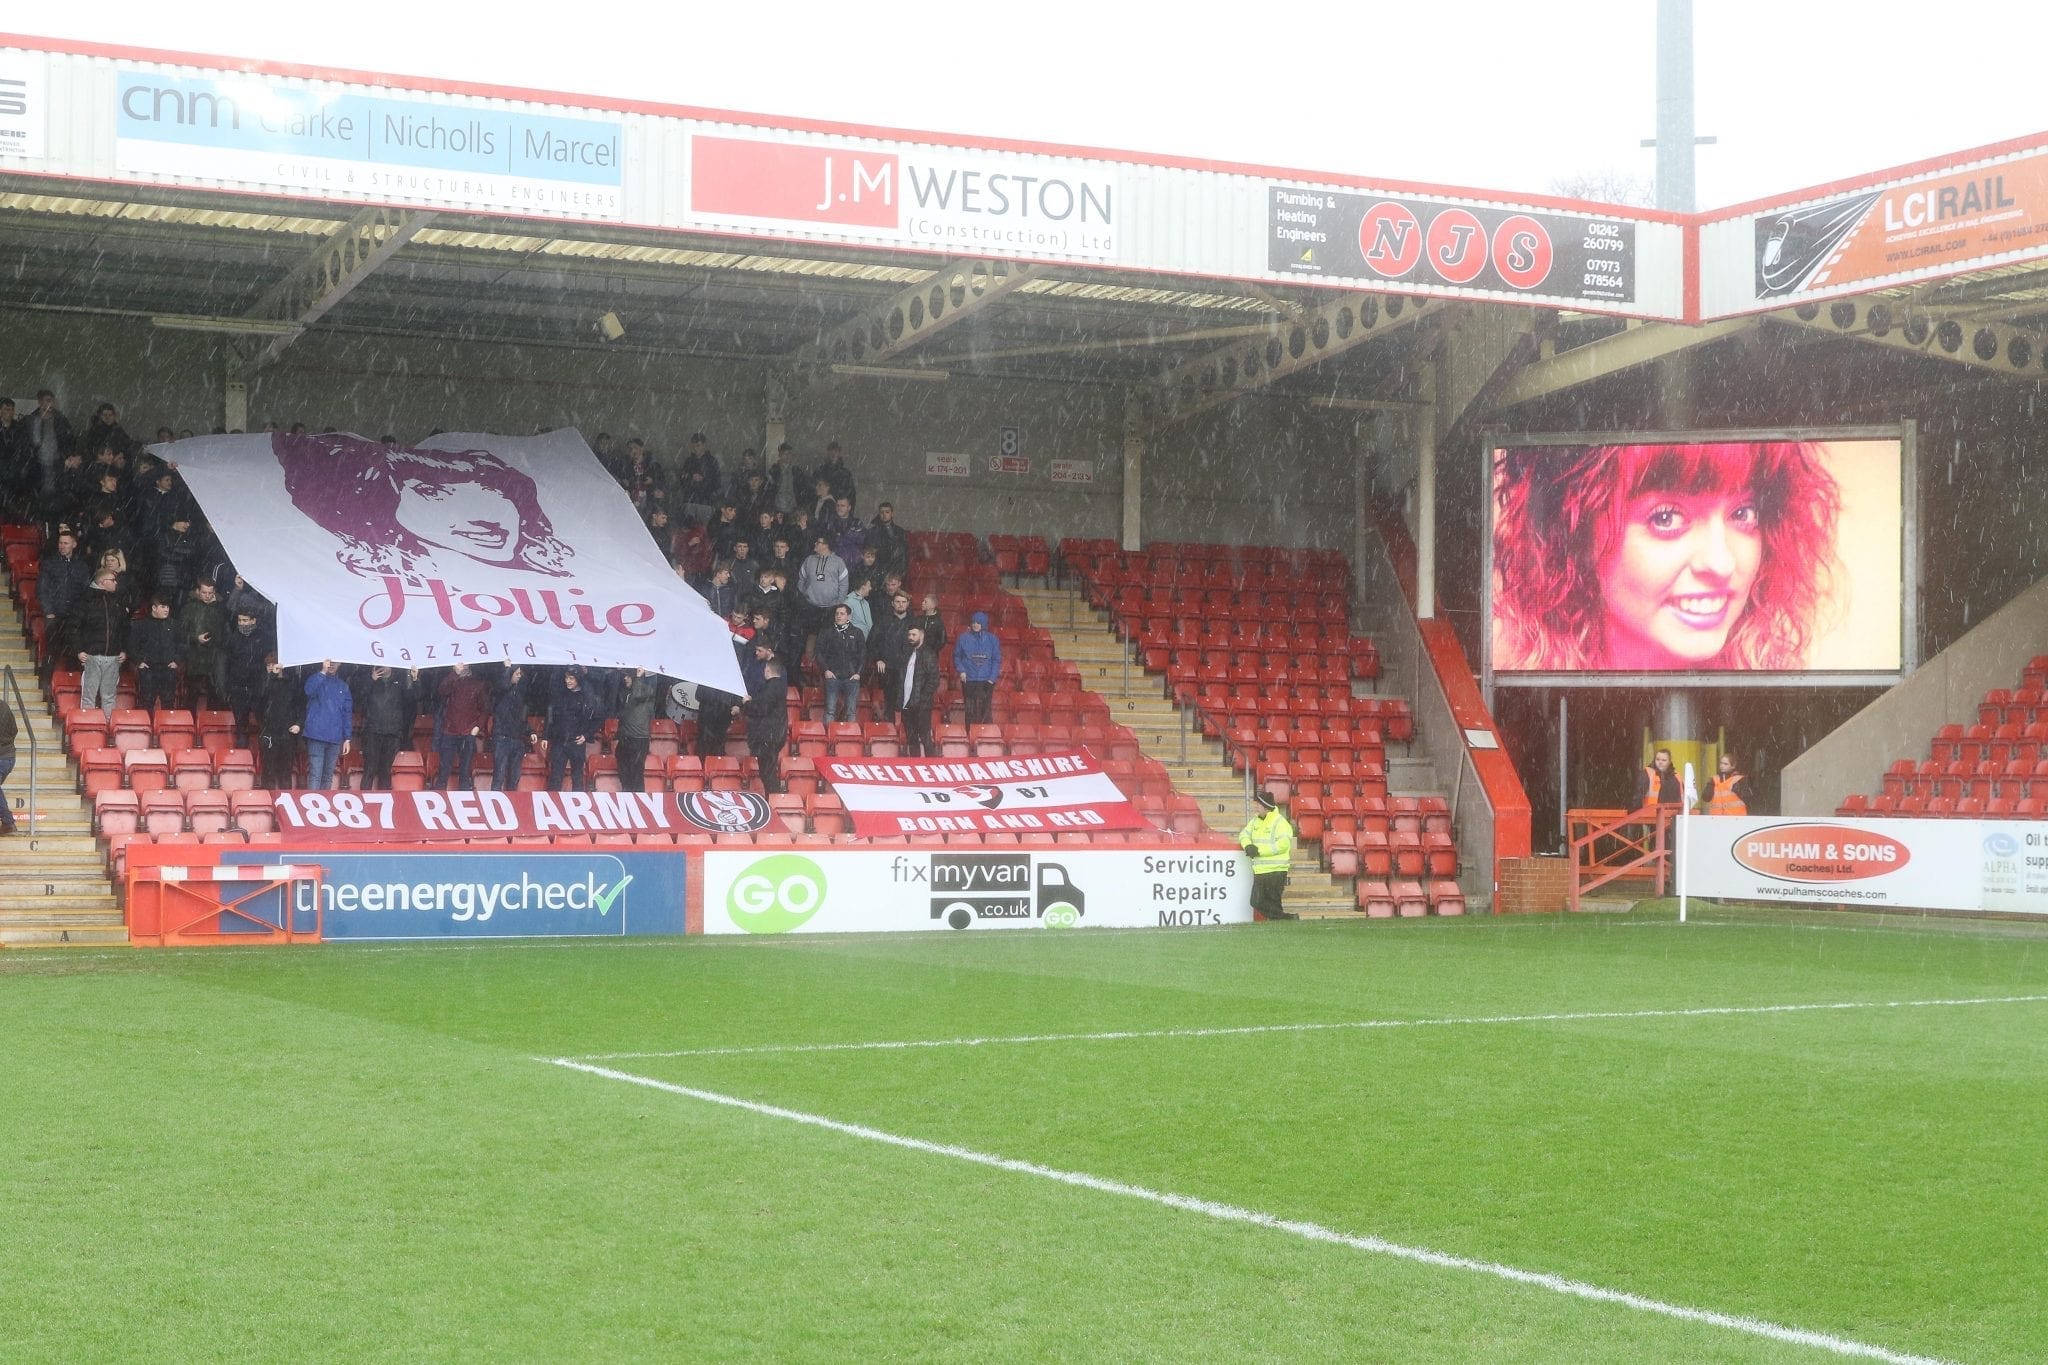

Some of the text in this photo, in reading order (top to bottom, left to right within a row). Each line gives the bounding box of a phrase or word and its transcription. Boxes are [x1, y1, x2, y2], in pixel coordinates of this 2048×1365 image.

[122, 85, 240, 129] cnm
[385, 114, 495, 155] Nicholls
[525, 128, 616, 167] Marcel
[277, 163, 616, 208] CIVIL & STRUCTURAL ENGINEERS
[816, 156, 1112, 225] J.M WESTON
[1276, 191, 1336, 210] Plumbing &
[1277, 209, 1317, 227] Heating
[909, 217, 1112, 250] (Construction) Ltd
[1277, 226, 1327, 243] Engineers
[1588, 223, 1619, 237] 01242
[1583, 237, 1624, 252] 260799
[1886, 239, 1967, 262] WWW.LCIRAIL.COM
[1587, 259, 1620, 273] 07973
[1583, 273, 1623, 288] 878564
[1002, 430, 1017, 454] 8
[358, 576, 657, 637] Hollie
[371, 640, 537, 661] Gazzard
[1127, 702, 1135, 710] G
[1156, 736, 1163, 744] F
[830, 755, 1088, 783] CHELTENHAMSHIRE
[1187, 769, 1194, 778] E
[16, 798, 25, 808] D
[275, 790, 671, 831] 1887 RED ARMY
[897, 809, 1105, 831] BORN AND RED
[30, 840, 39, 851] C
[2026, 833, 2041, 846] Oil
[1748, 842, 1897, 862] PULHAM & SONS
[891, 856, 928, 882] fix
[1143, 856, 1235, 877] Servicing
[1786, 863, 1855, 874] (Coaches) Ltd.
[1983, 860, 2017, 873] ALPHA
[45, 884, 55, 895] B
[296, 871, 608, 921] theenergycheck
[733, 874, 819, 914] GO
[1153, 882, 1227, 904] Repairs
[1756, 886, 1887, 899] www.pulhamscoaches.com
[980, 899, 1028, 917] .co.uk
[1046, 910, 1074, 926] GO
[60, 930, 69, 941] A
